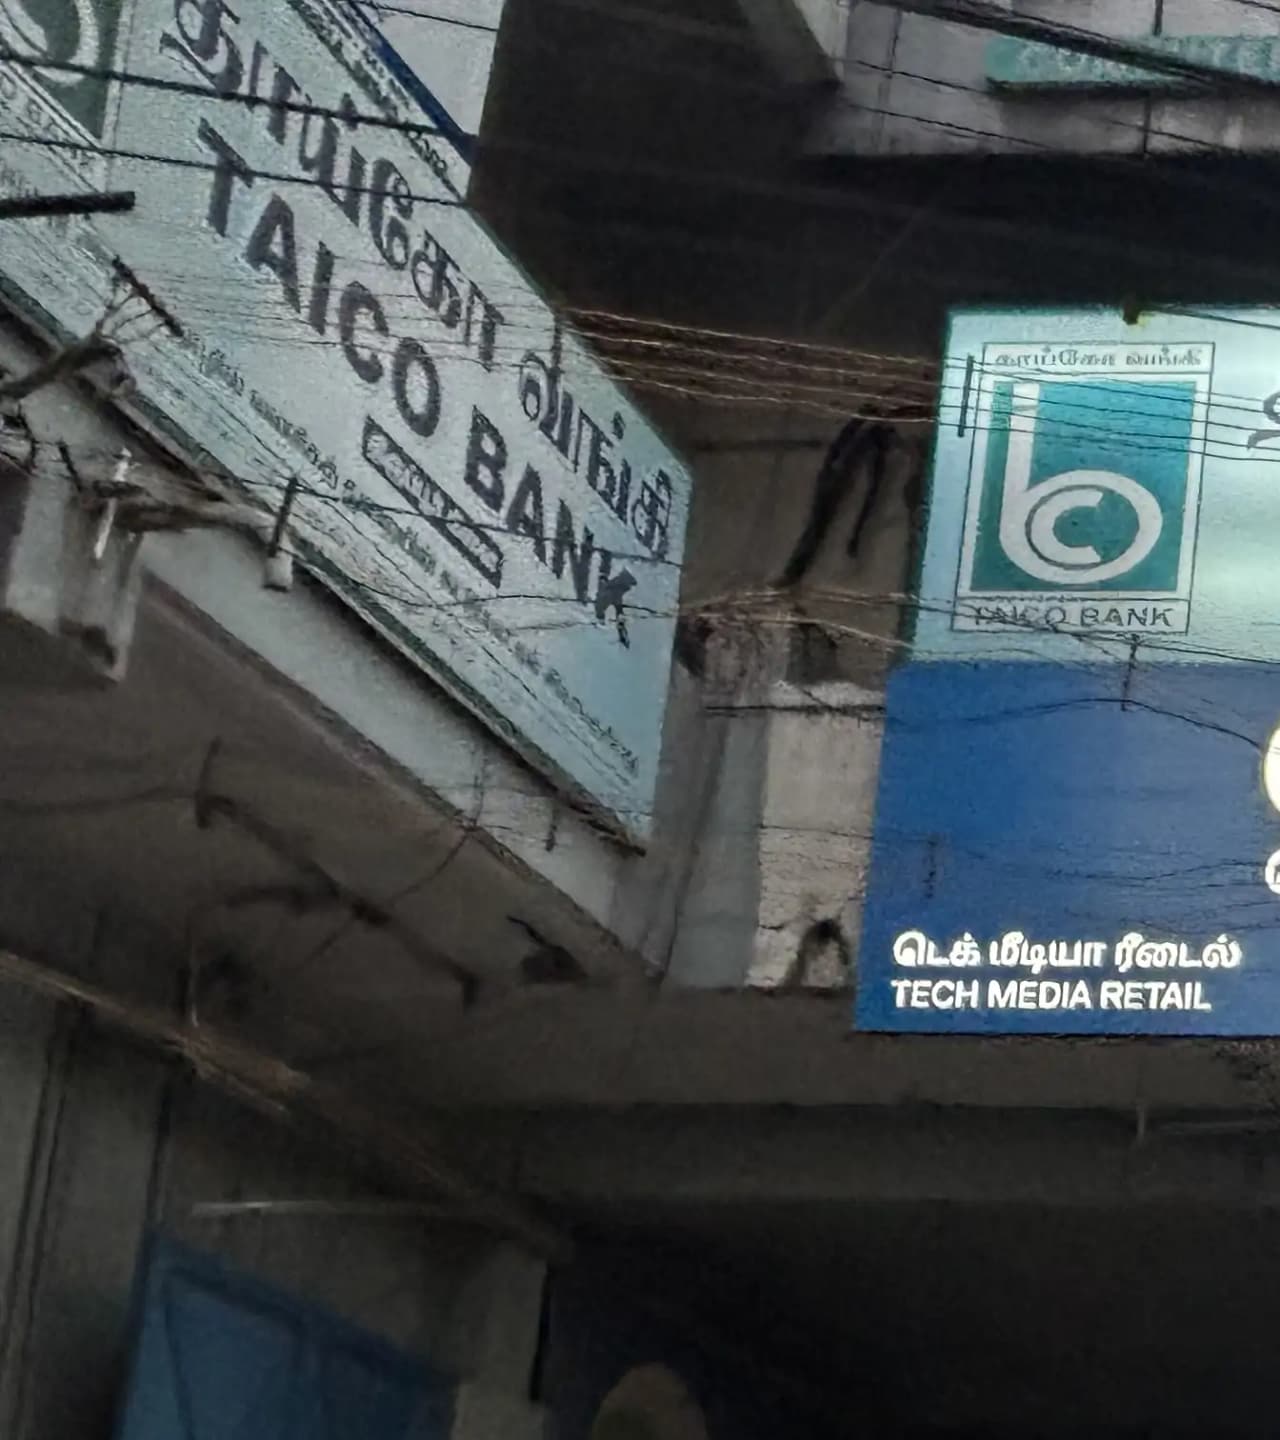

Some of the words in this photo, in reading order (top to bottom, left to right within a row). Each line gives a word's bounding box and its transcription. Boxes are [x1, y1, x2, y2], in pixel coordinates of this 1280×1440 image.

[198, 117, 442, 438] TAICO
[464, 404, 638, 650] BANK
[1080, 607, 1176, 627] BANK
[893, 929, 982, 968] டெக்
[890, 979, 980, 1010] TECH
[987, 979, 1094, 1011] MEDIA
[1100, 980, 1213, 1012] RETAIL
